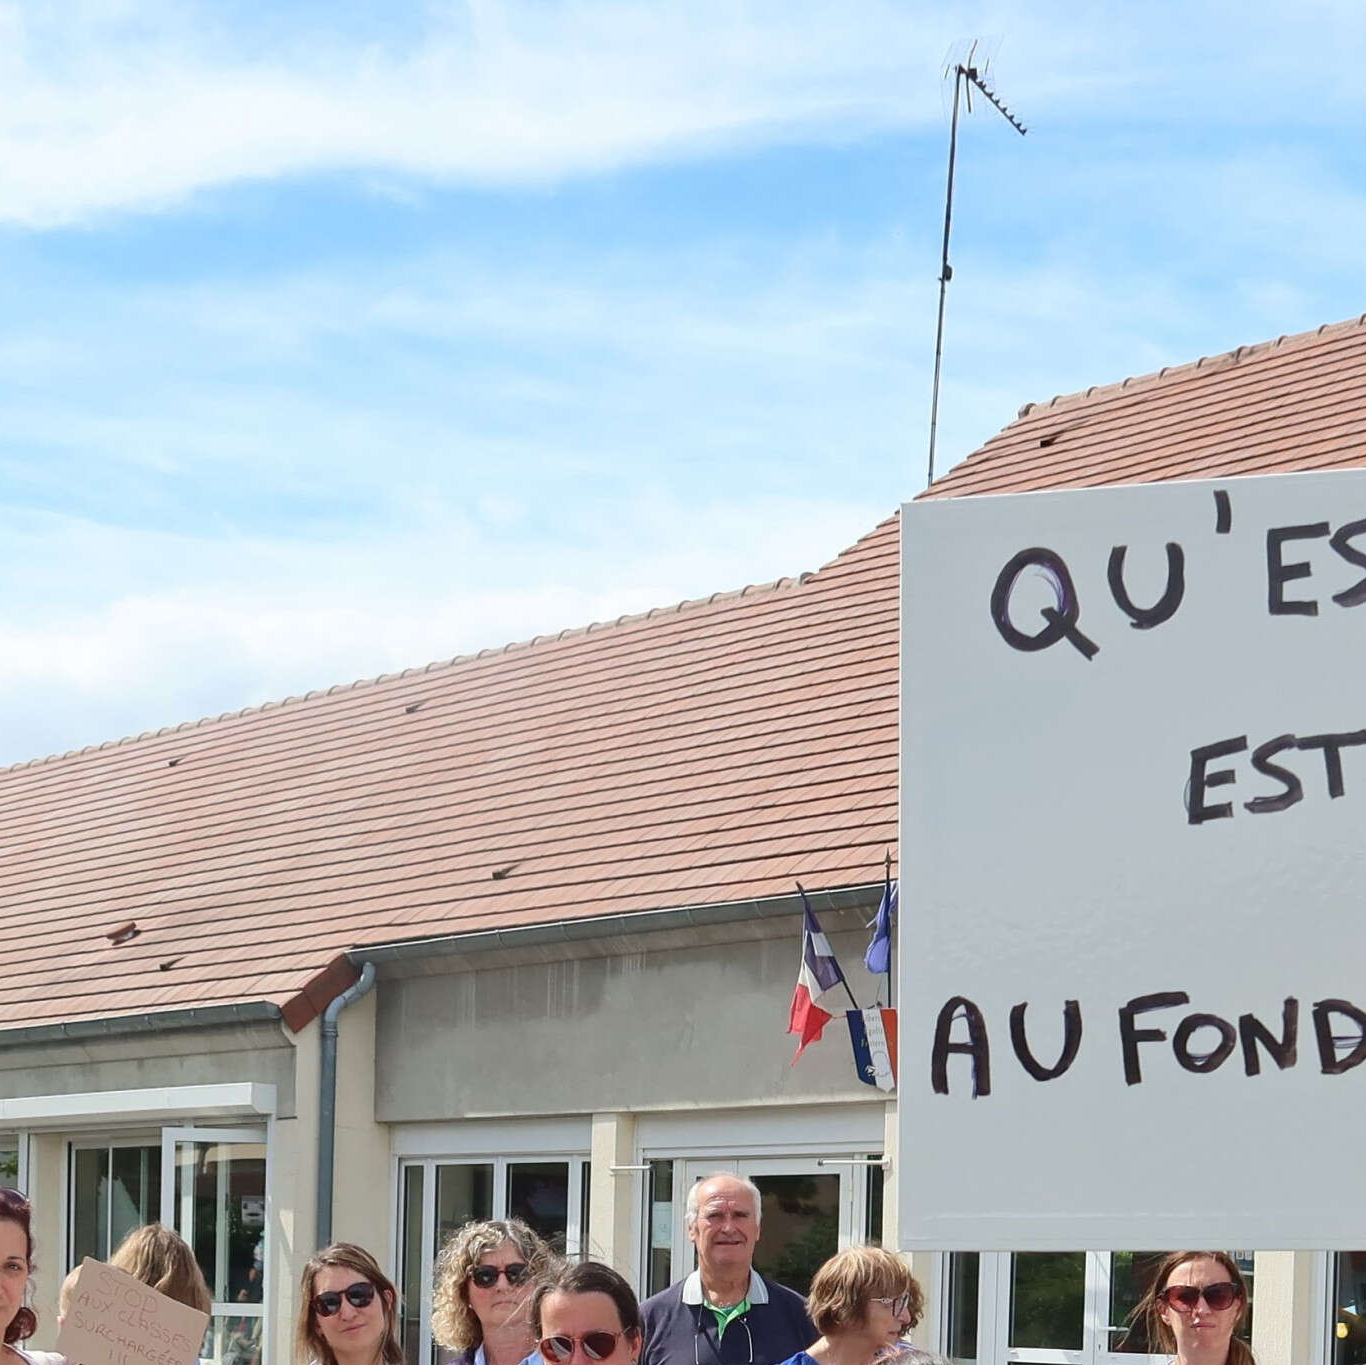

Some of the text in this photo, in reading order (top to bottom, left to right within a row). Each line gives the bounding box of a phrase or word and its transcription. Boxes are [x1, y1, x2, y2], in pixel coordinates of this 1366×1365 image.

[931, 996, 1081, 1098] AU
[77, 1291, 192, 1353] AUX CLASSES
[97, 1271, 157, 1320] STOP
